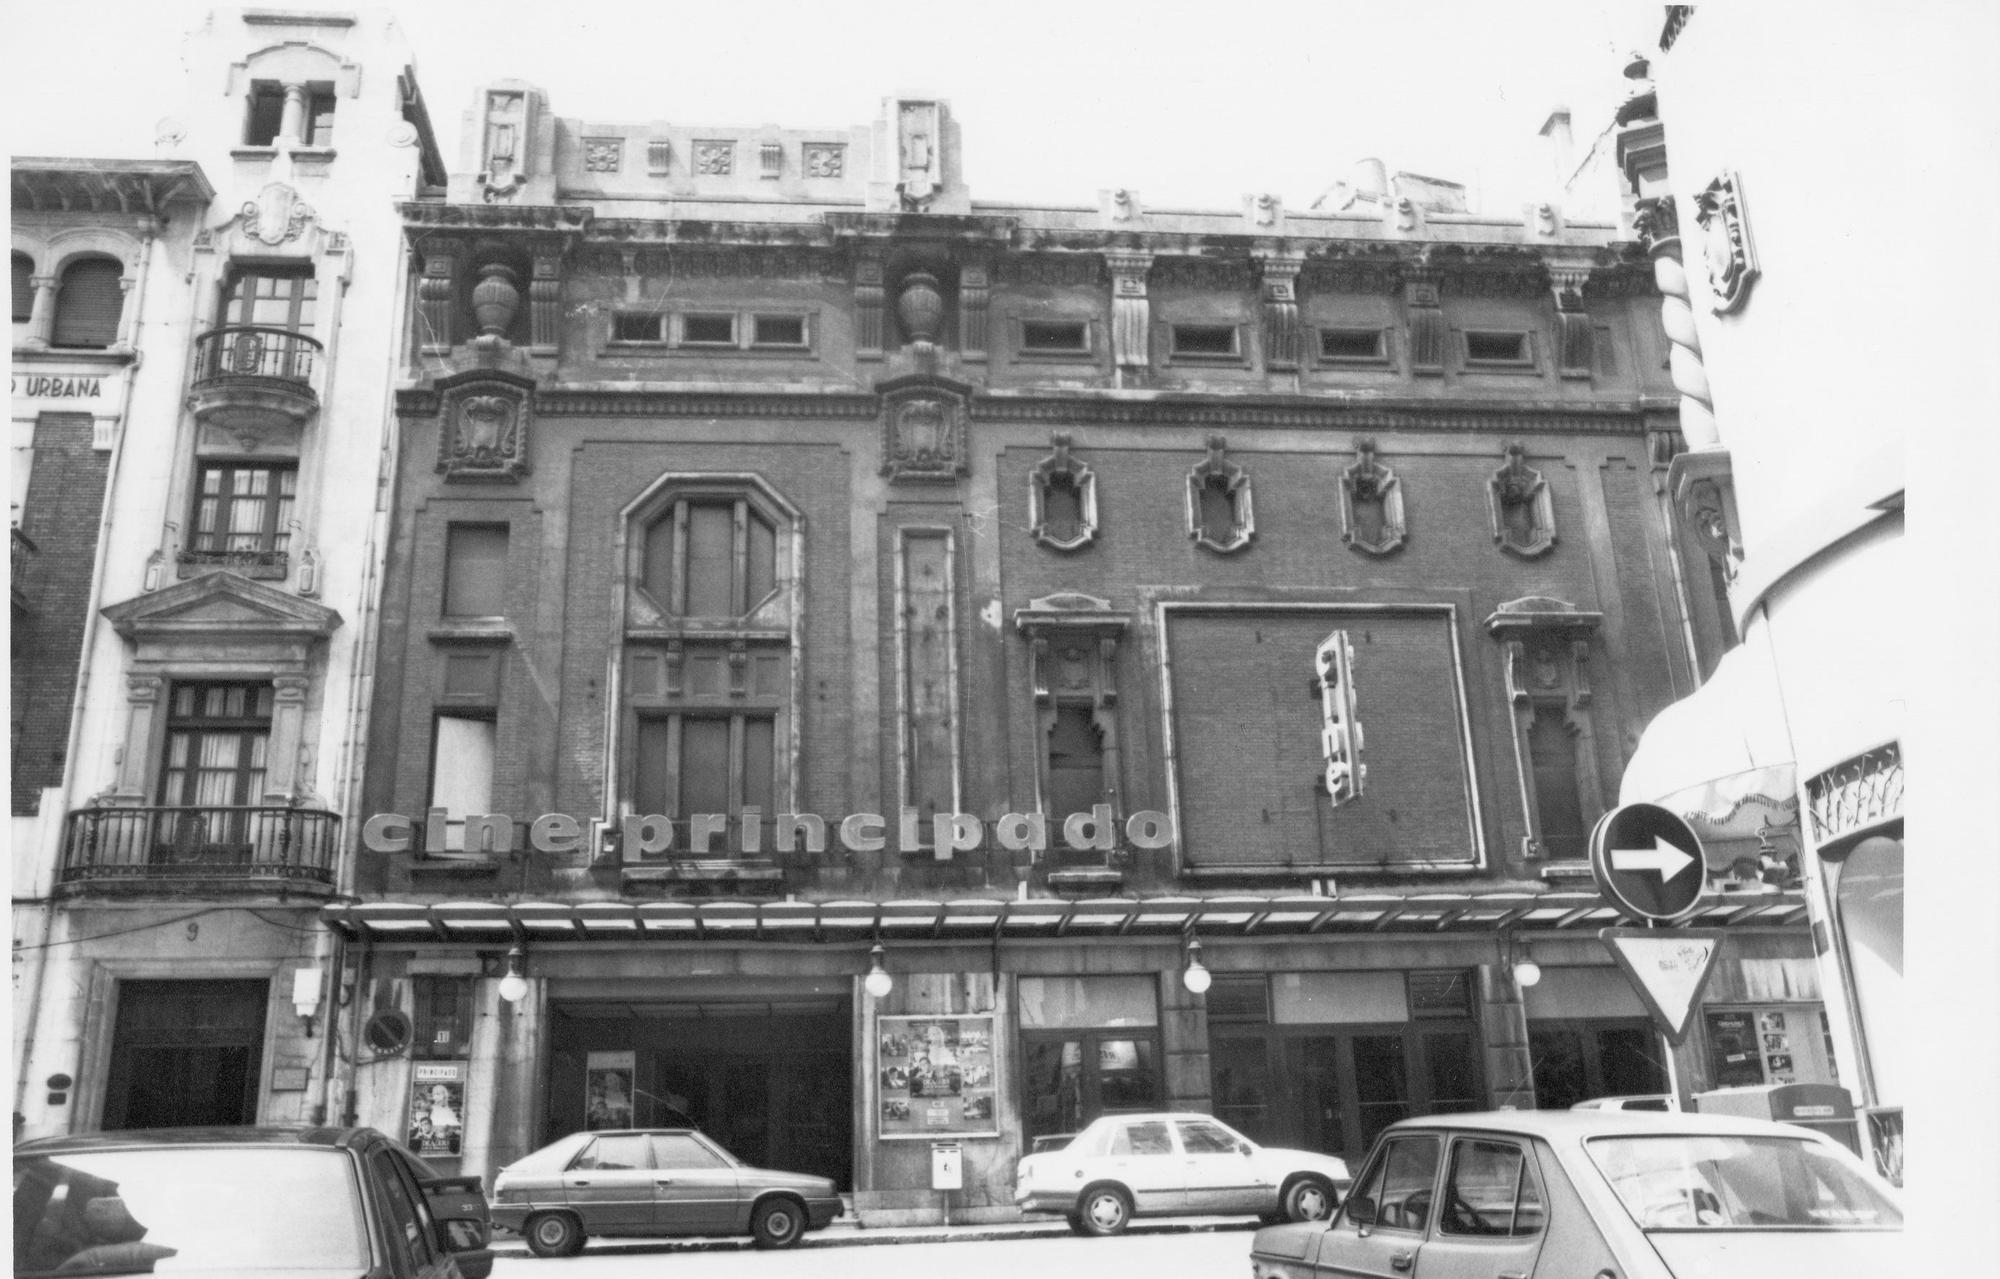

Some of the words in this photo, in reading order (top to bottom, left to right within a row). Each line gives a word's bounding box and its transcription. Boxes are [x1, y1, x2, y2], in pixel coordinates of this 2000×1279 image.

[26, 377, 101, 398] URBANA
[362, 805, 581, 853] cine
[622, 803, 1174, 863] principado
[186, 922, 199, 942] 9
